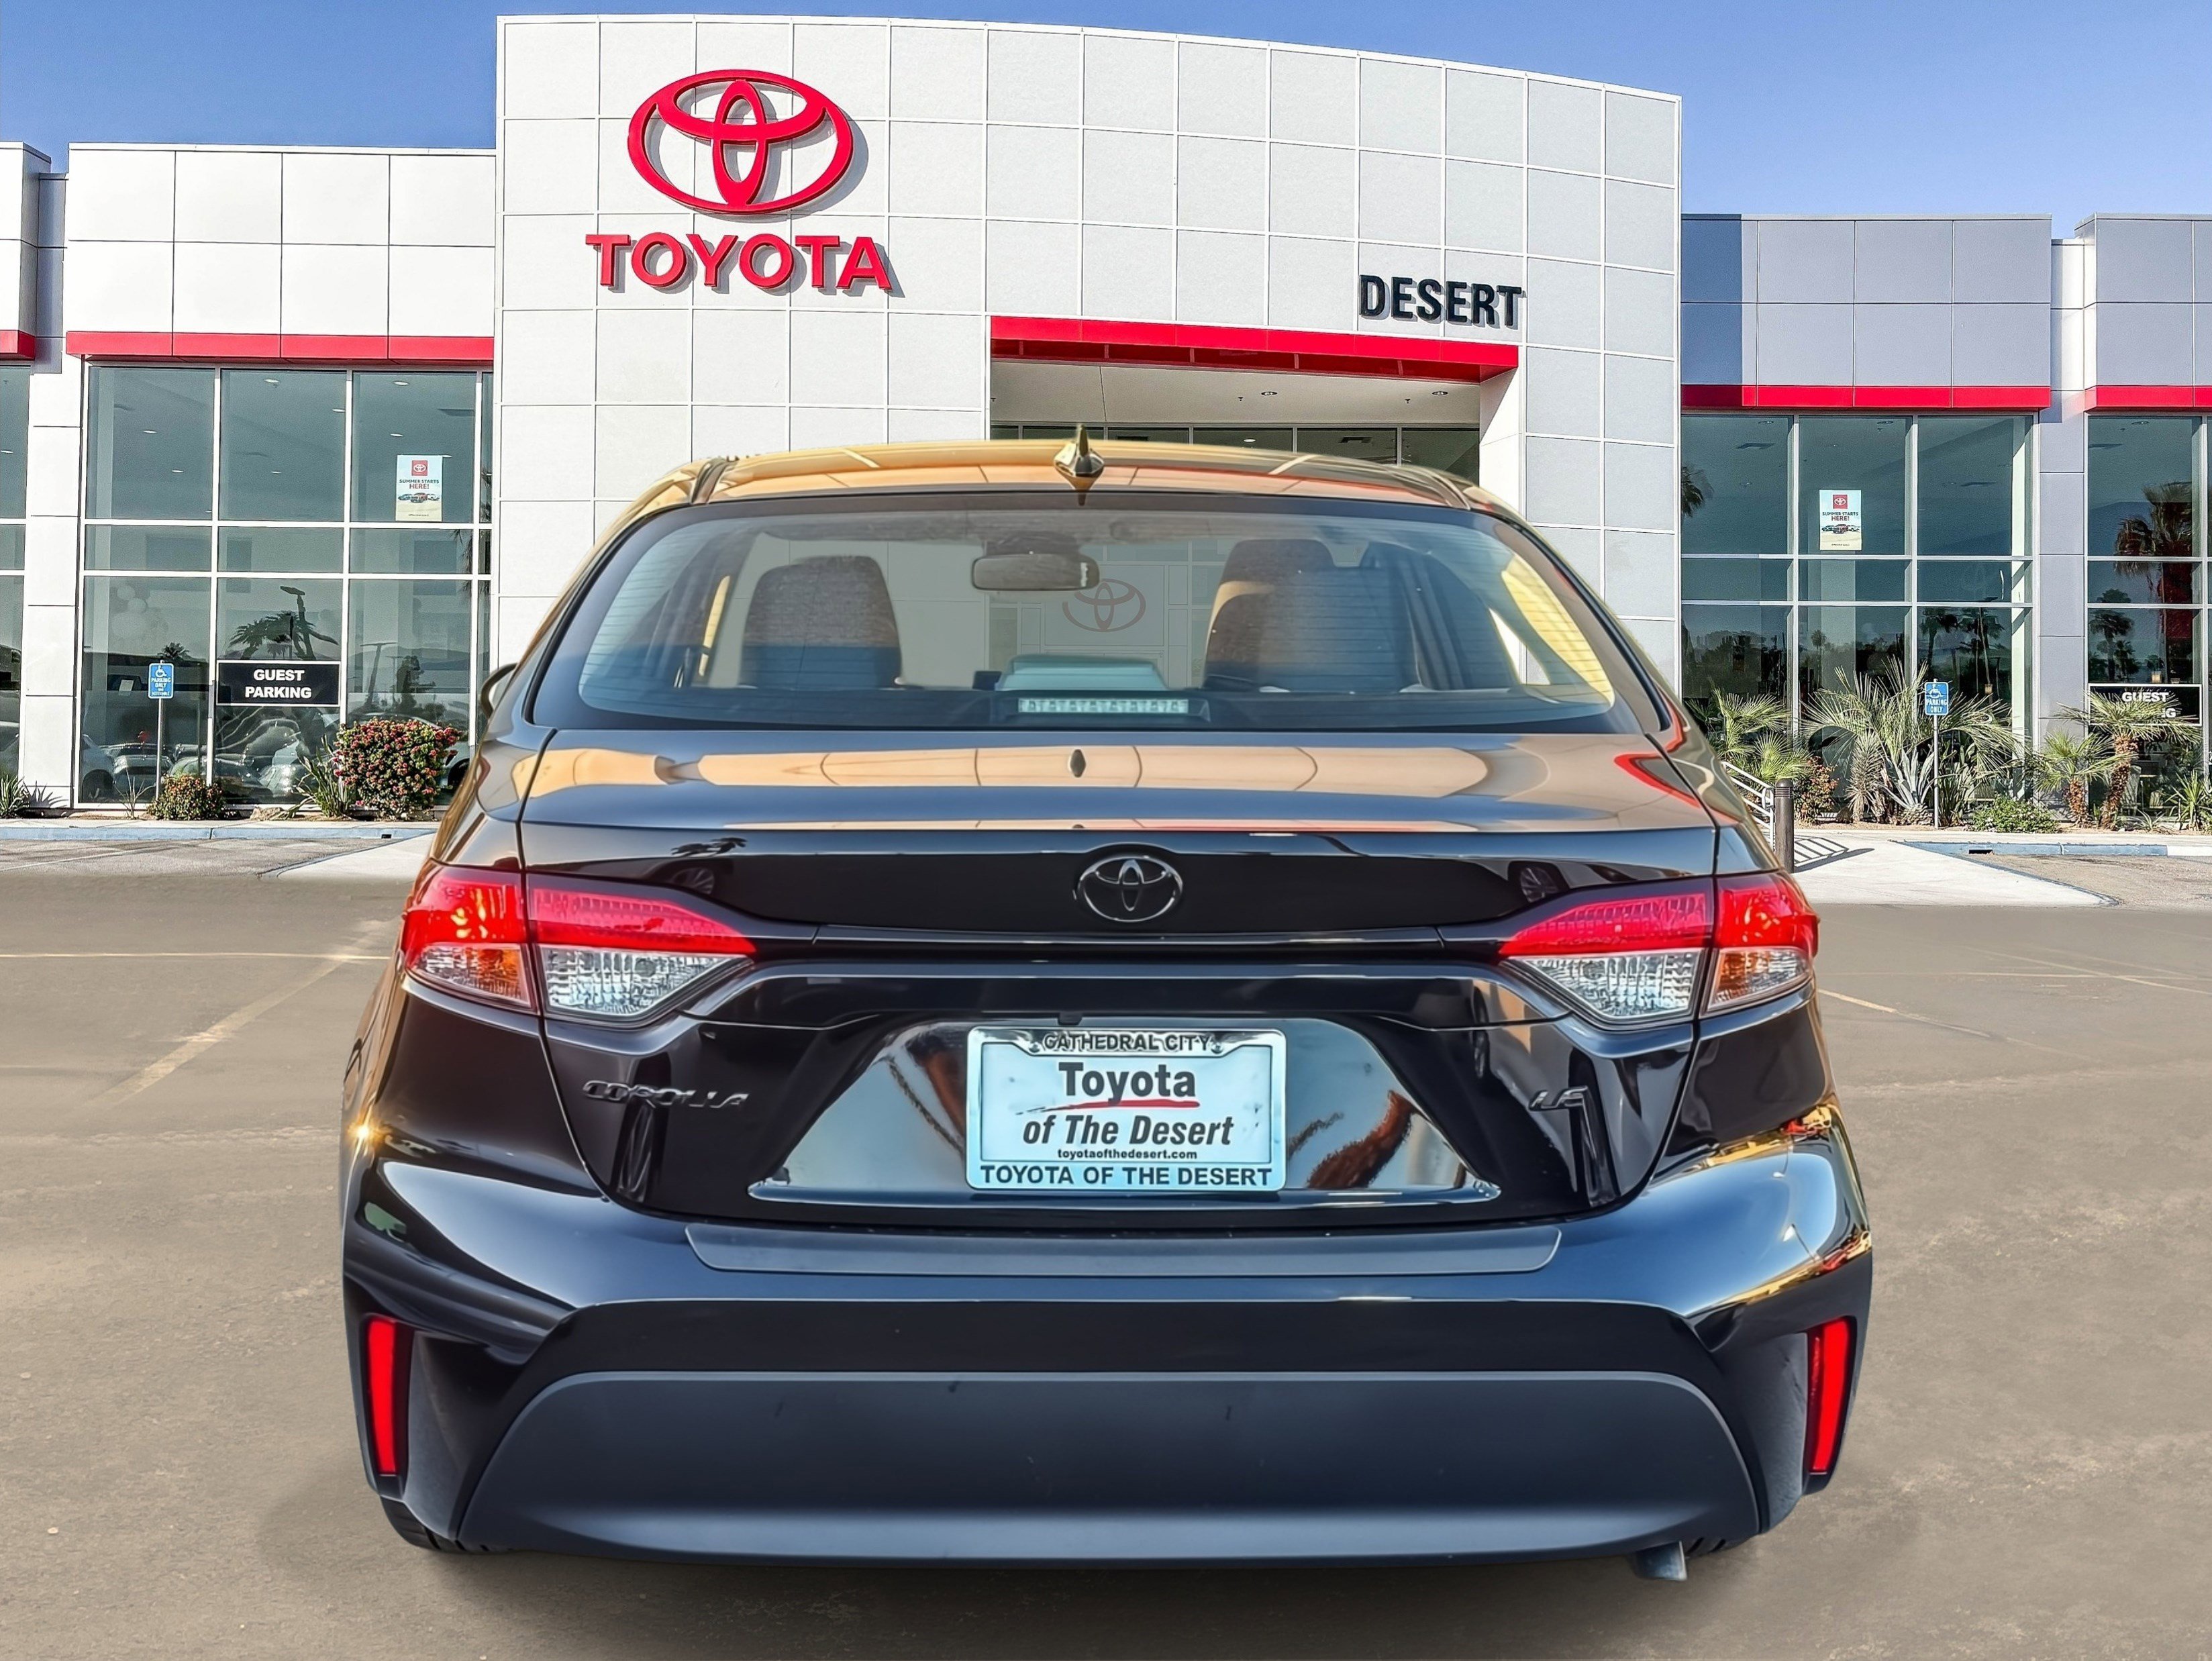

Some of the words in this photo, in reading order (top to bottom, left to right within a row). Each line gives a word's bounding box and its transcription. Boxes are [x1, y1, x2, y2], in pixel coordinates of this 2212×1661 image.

[585, 232, 892, 291] TOYOTA
[1359, 274, 1522, 326] DESERT
[253, 669, 305, 681] GUEST
[245, 686, 312, 699] PARKING
[2121, 691, 2169, 703] GUEST
[1930, 705, 1943, 713] ONLY
[1044, 1034, 1160, 1051] CATHEDRAL
[1165, 1034, 1211, 1051] CITY
[1058, 1062, 1196, 1105] Toyota
[1023, 1115, 1056, 1145] of
[1065, 1115, 1119, 1145] The
[1129, 1115, 1234, 1145] Desert
[1058, 1148, 1197, 1160] toyotaofthedesert.com
[981, 1165, 1074, 1185] TOYOTA
[1083, 1166, 1114, 1185] OF
[1122, 1167, 1170, 1185] THE
[1177, 1168, 1272, 1186] DESERT
